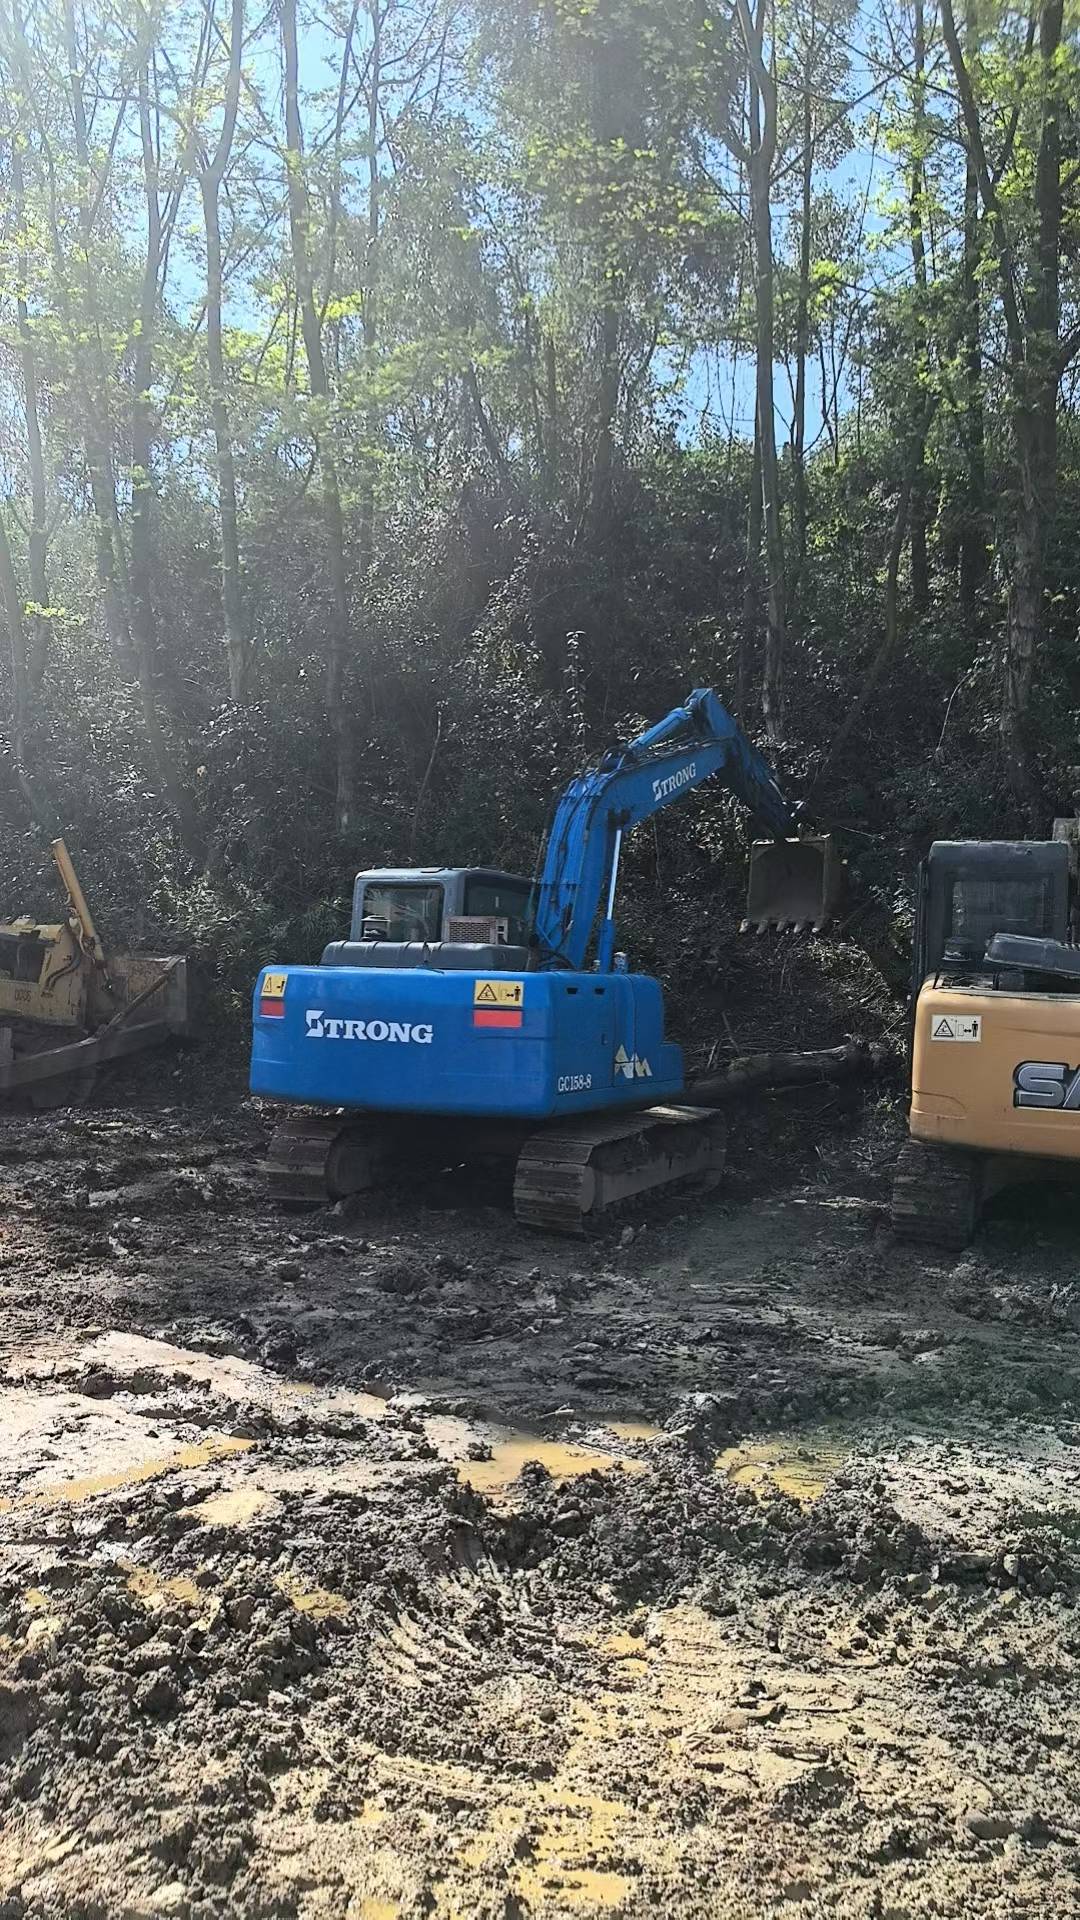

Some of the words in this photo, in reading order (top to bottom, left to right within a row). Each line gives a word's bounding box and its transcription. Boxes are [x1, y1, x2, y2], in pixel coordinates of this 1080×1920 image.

[652, 762, 697, 803] STRONG
[305, 1009, 434, 1044] STRONG
[557, 1073, 592, 1092] GC158-8
